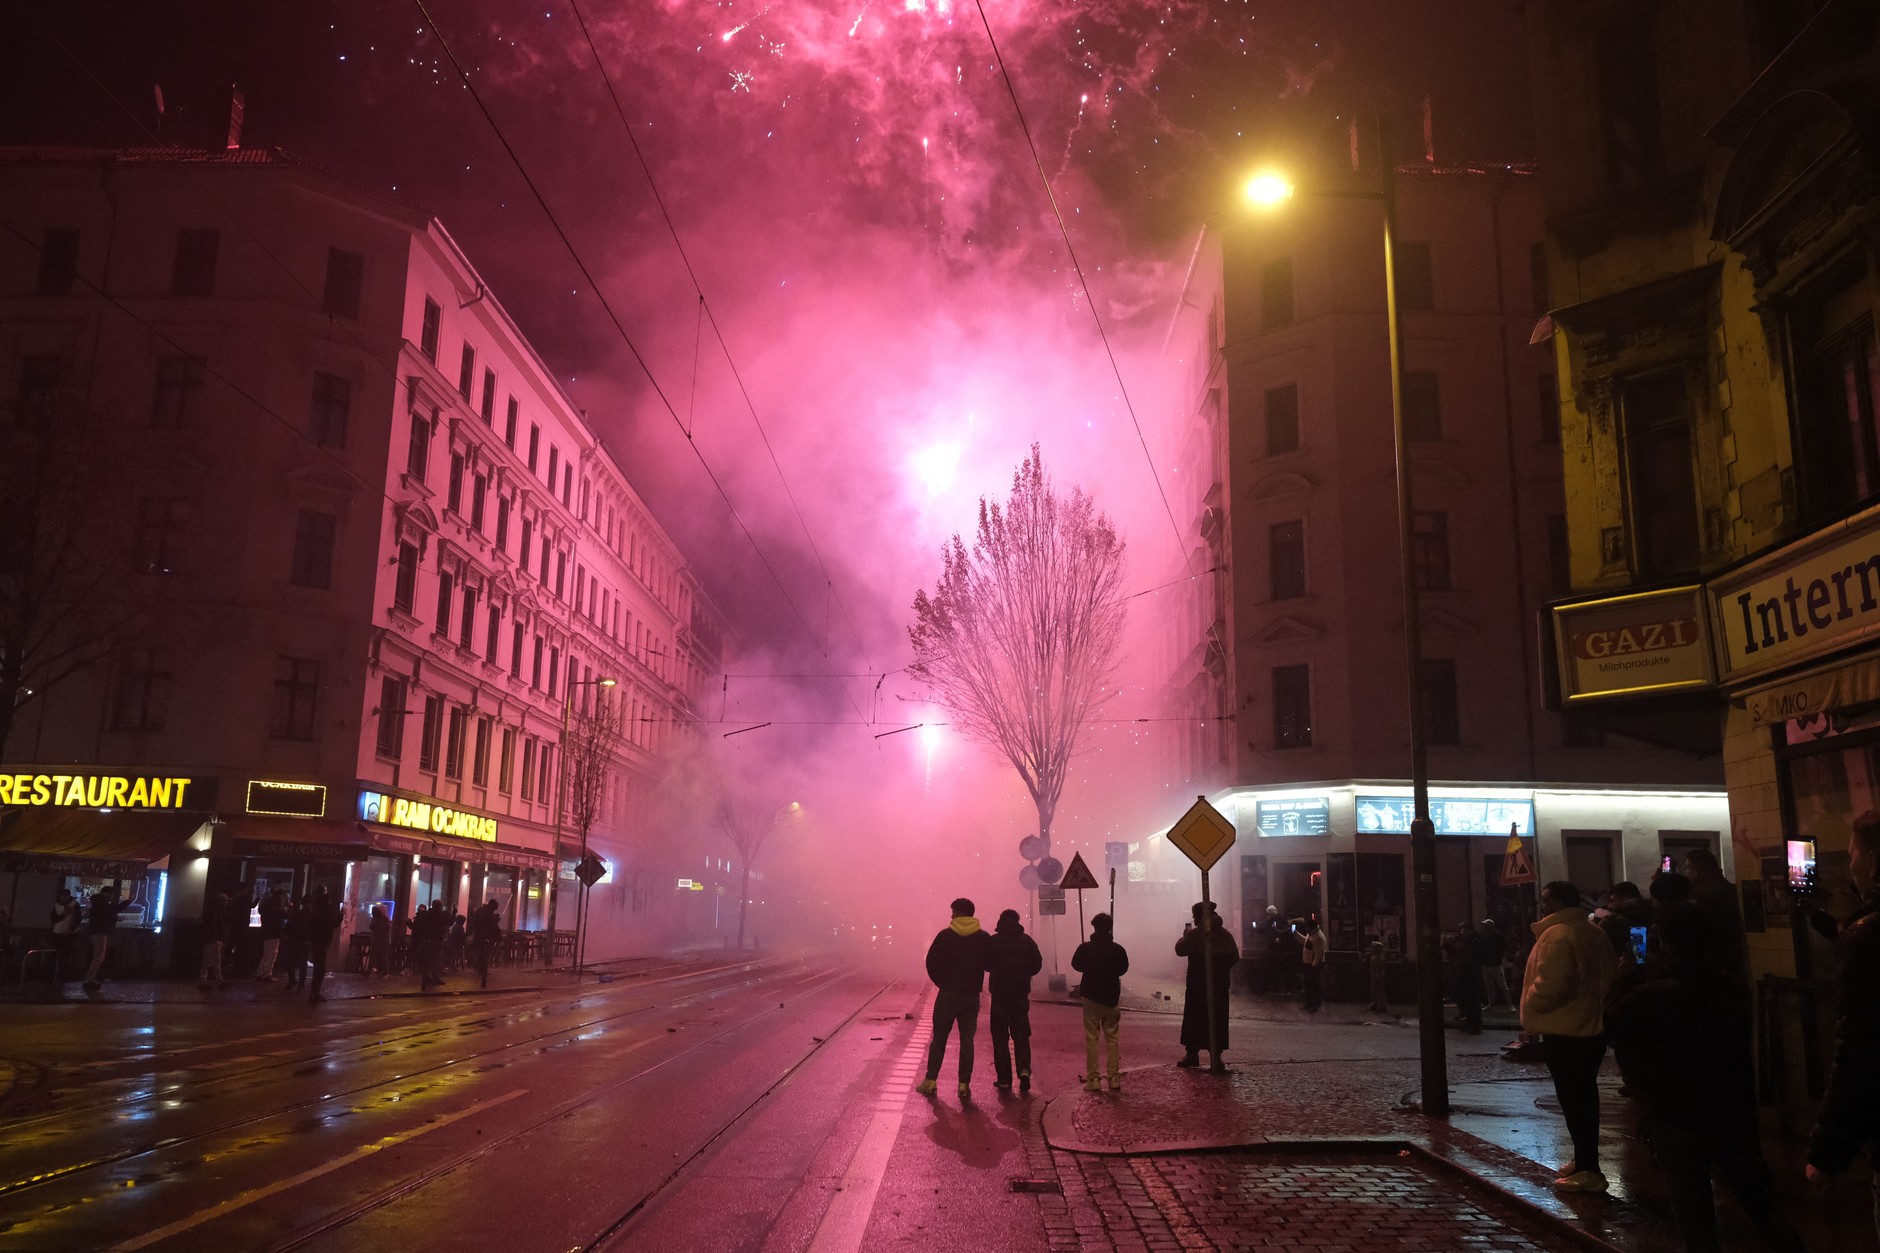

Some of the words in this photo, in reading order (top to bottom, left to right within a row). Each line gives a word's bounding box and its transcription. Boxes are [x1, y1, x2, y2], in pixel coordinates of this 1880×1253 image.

[1738, 554, 1880, 655] Intern
[1585, 620, 1687, 658] GAZI
[1599, 656, 1671, 673] Milchprodukte
[0, 774, 191, 808] RESTAURANT
